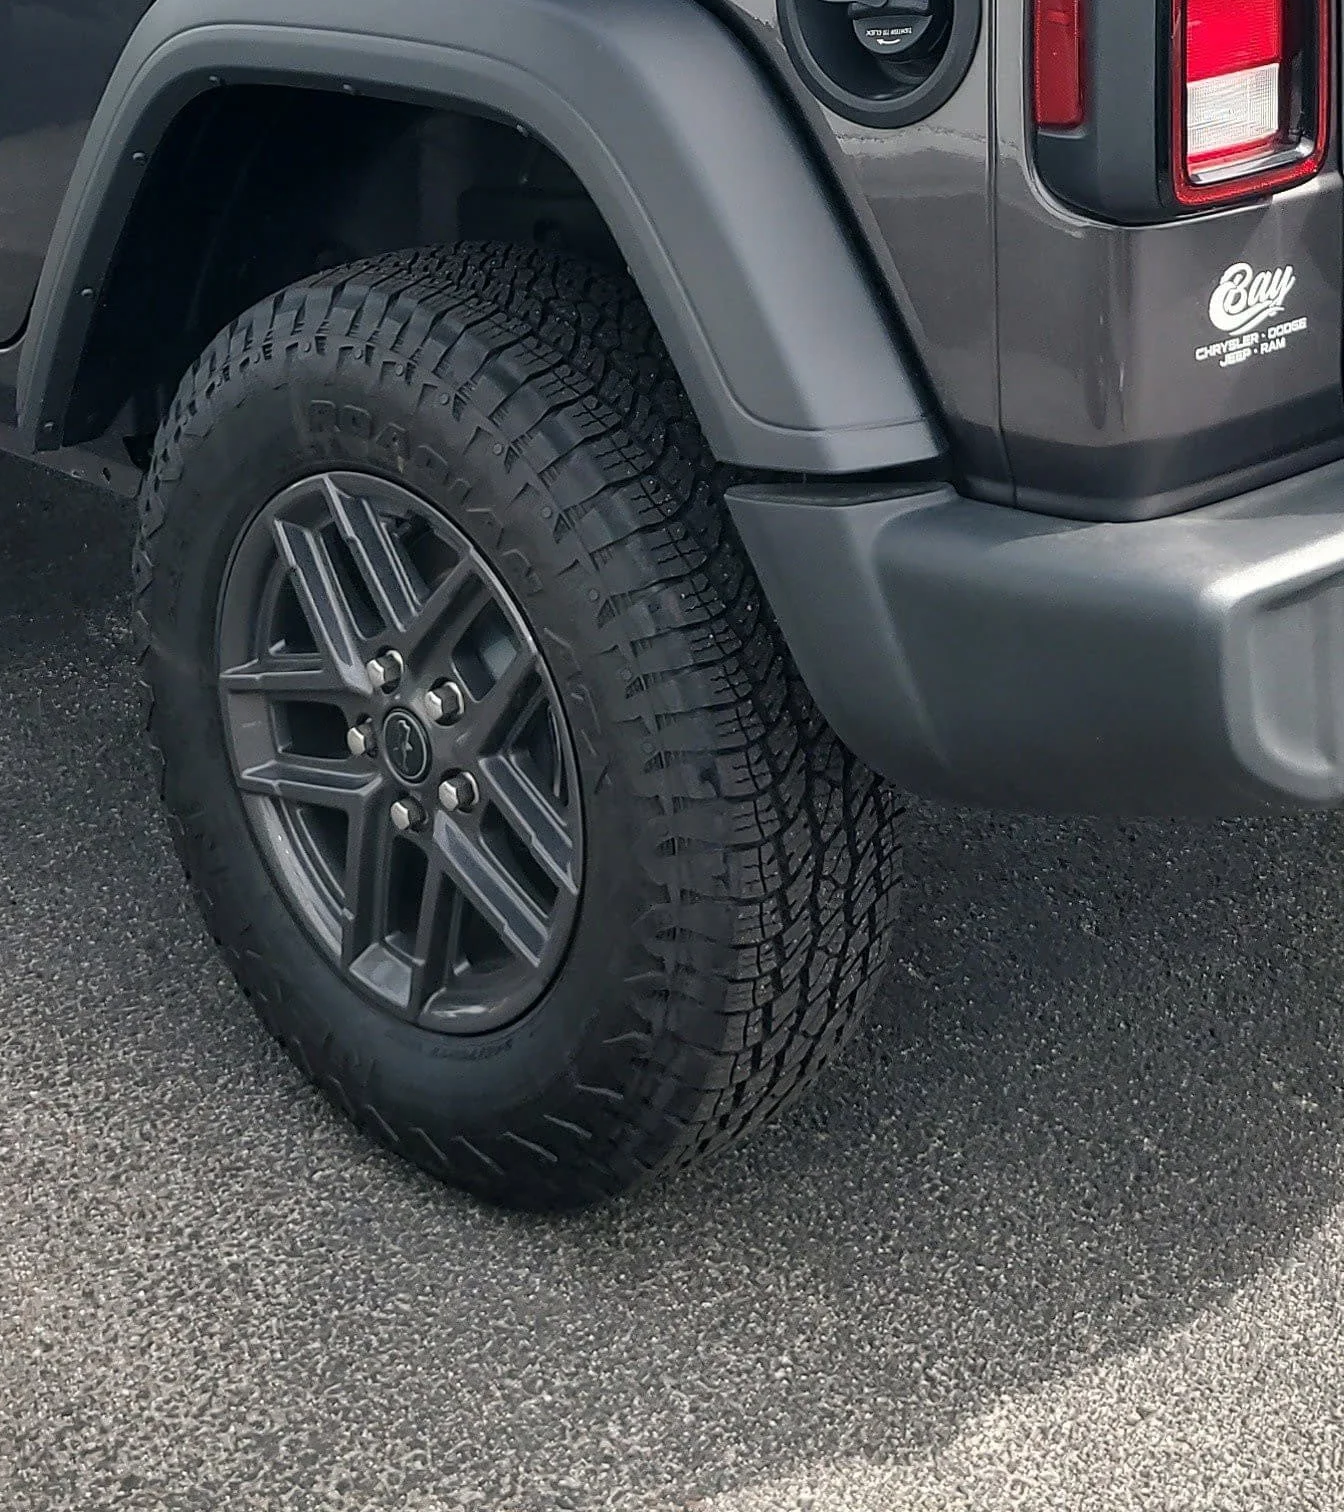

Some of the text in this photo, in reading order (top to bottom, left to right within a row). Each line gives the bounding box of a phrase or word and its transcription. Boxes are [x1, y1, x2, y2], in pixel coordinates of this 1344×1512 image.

[1208, 262, 1296, 336] Bay
[1195, 317, 1307, 361] CHRYSLER DODGE
[1219, 337, 1286, 367] JEEP RAM
